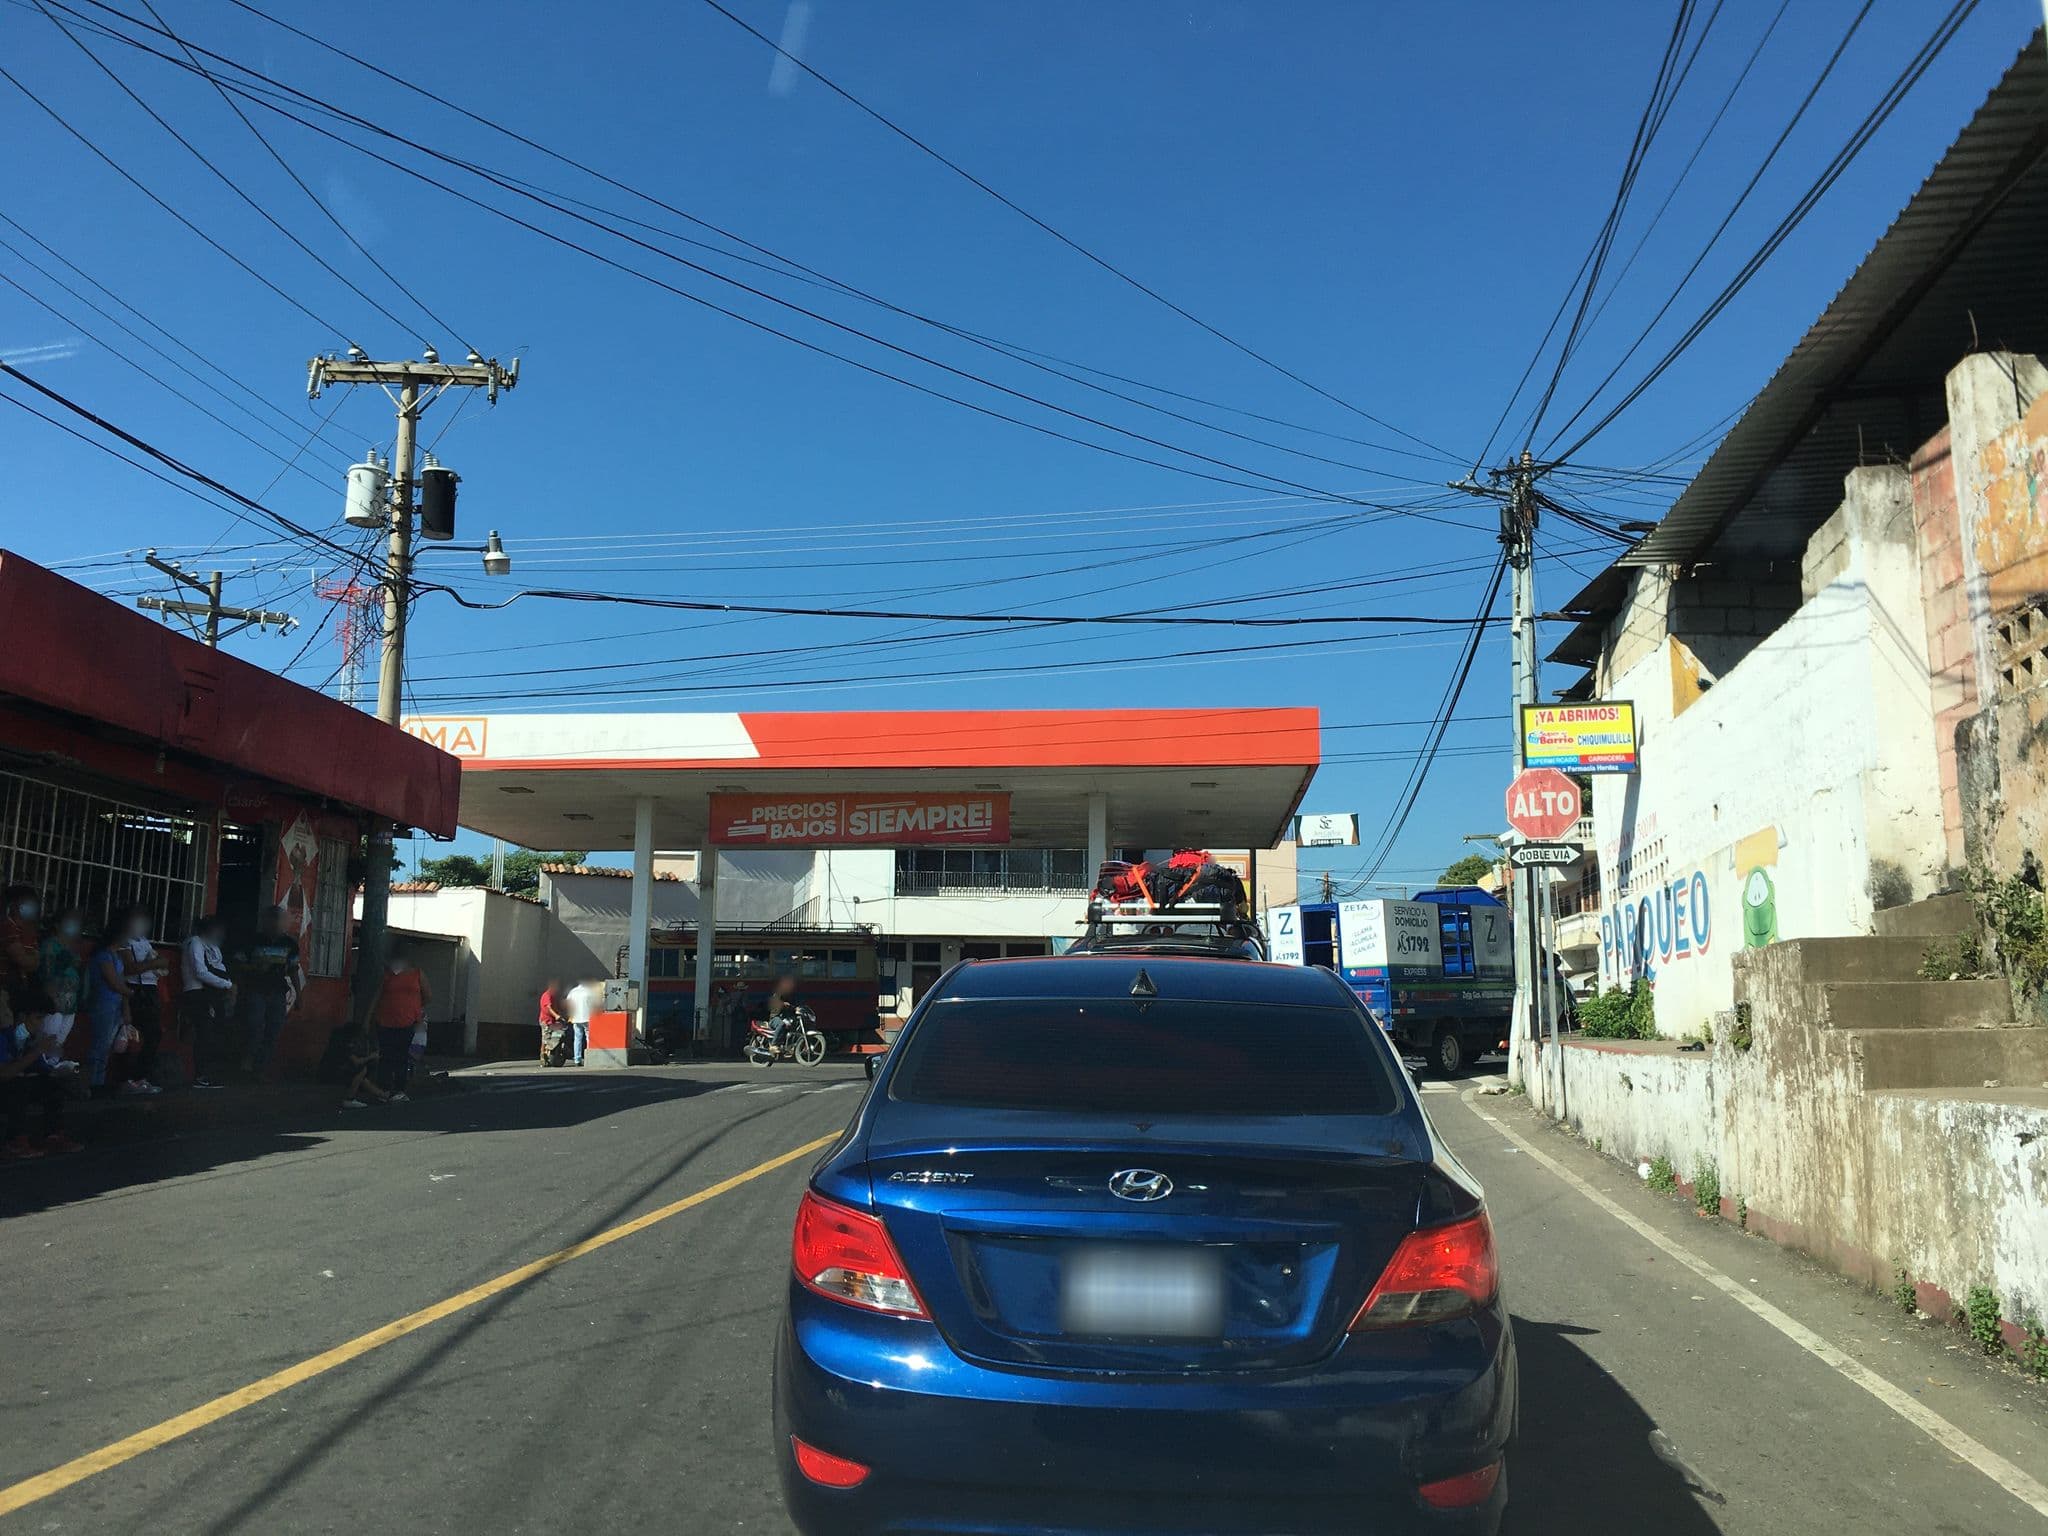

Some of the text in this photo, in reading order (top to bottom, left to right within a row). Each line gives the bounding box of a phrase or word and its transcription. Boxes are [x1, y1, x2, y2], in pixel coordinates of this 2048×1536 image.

[1559, 708, 1619, 723] ABRIMOS!
[408, 726, 477, 752] MA
[1540, 735, 1574, 745] Barrio
[1577, 733, 1632, 746] CHIQUIMULILLA
[752, 801, 837, 823] PRECIOS
[1513, 791, 1575, 818] ALTO
[849, 800, 993, 836] SIEMPRE!
[769, 820, 837, 840] BAJOS
[1520, 850, 1571, 861] DOBLE VIA
[1344, 903, 1369, 912] ZETA
[1394, 906, 1427, 917] SERVICIO A
[1278, 912, 1293, 935] Z
[1395, 917, 1429, 928] DOMICILIO
[1484, 914, 1497, 942] Z
[1601, 870, 1711, 988] PARQUEO
[1406, 935, 1430, 953] 1792
[1282, 952, 1299, 960] 1792
[1403, 968, 1427, 976] EXPRESS
[888, 1171, 974, 1183] ACCENT
